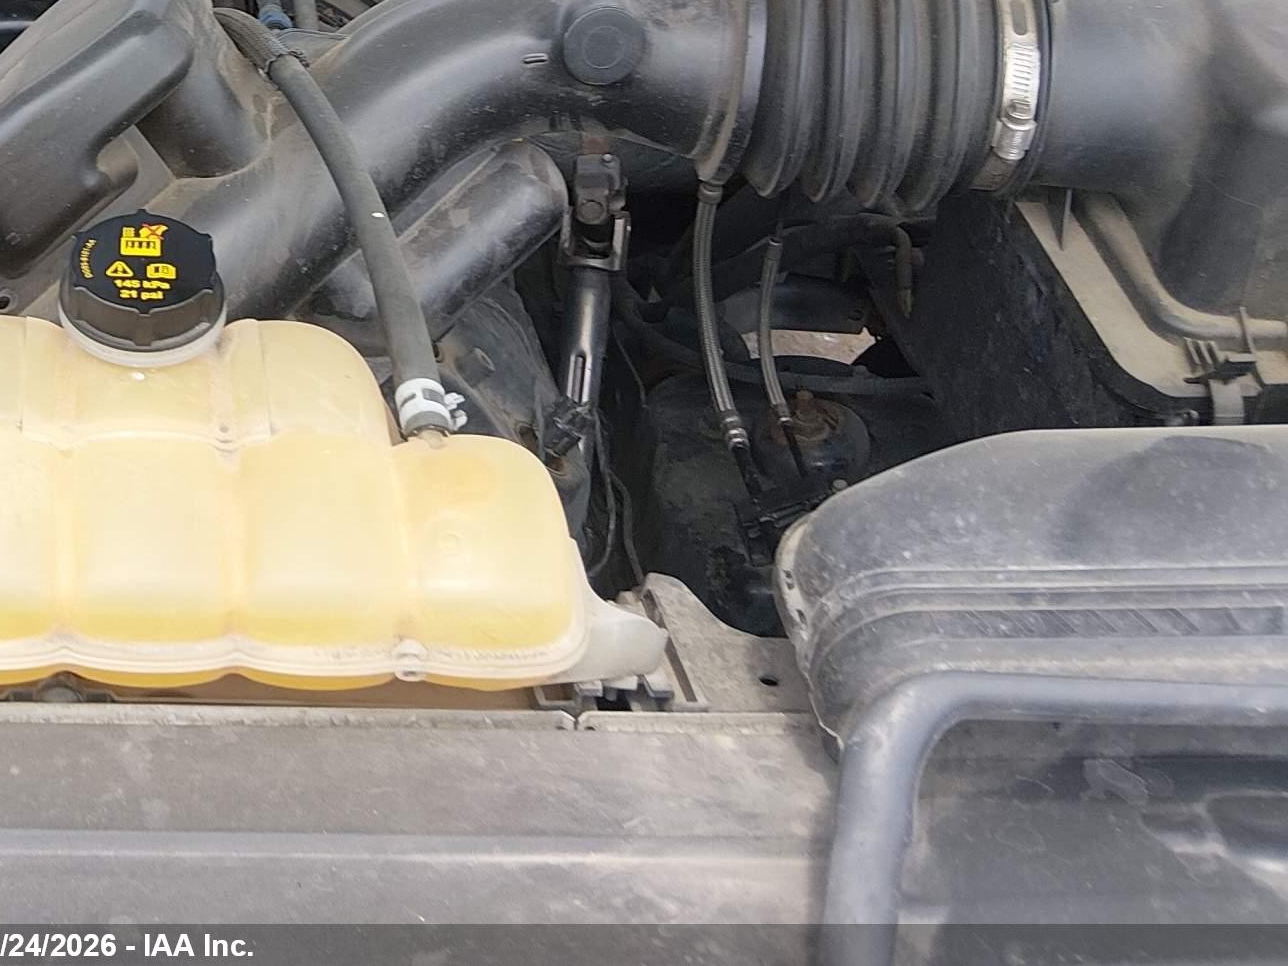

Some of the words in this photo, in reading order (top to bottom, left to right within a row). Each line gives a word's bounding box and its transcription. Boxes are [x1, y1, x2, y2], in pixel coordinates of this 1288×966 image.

[114, 279, 141, 289] 145
[142, 280, 171, 290] kPa
[120, 289, 138, 299] 21
[140, 290, 163, 301] psi
